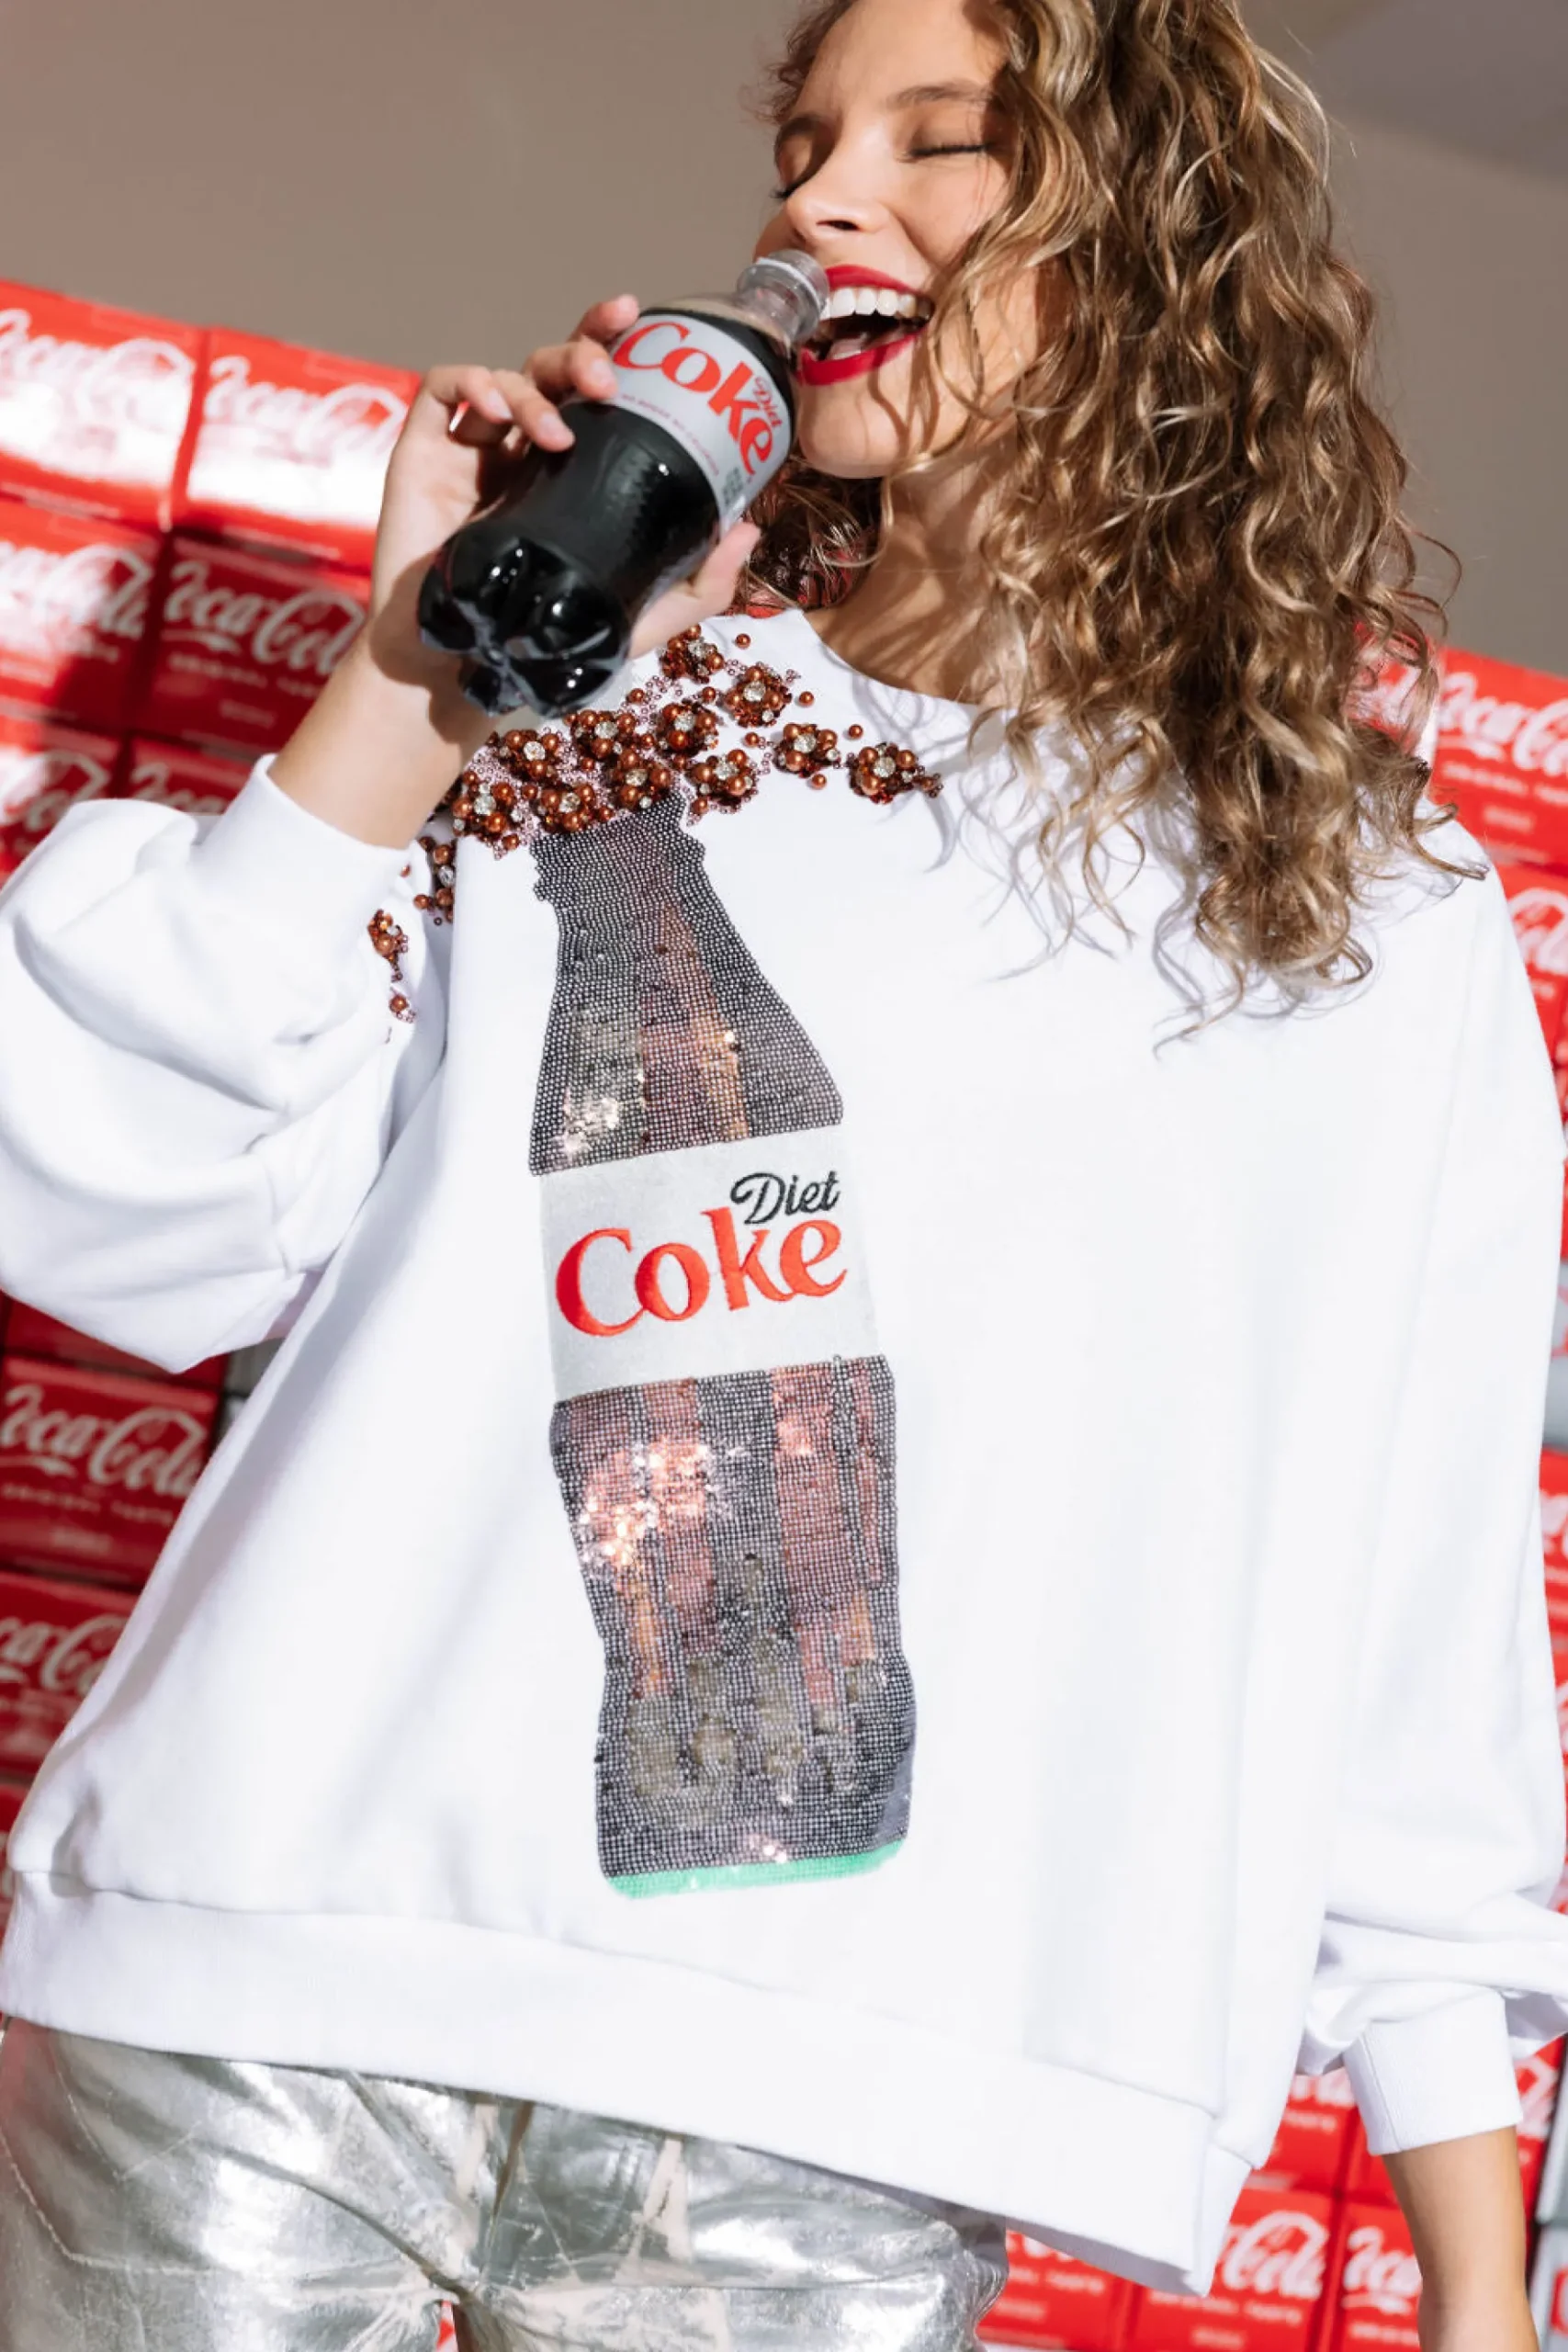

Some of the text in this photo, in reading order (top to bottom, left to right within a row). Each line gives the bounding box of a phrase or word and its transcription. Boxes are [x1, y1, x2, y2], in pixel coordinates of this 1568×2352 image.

[612, 321, 773, 477] Coke
[753, 376, 783, 428] Diet
[730, 1170, 840, 1226] Diet
[555, 1206, 847, 1338] Coke
